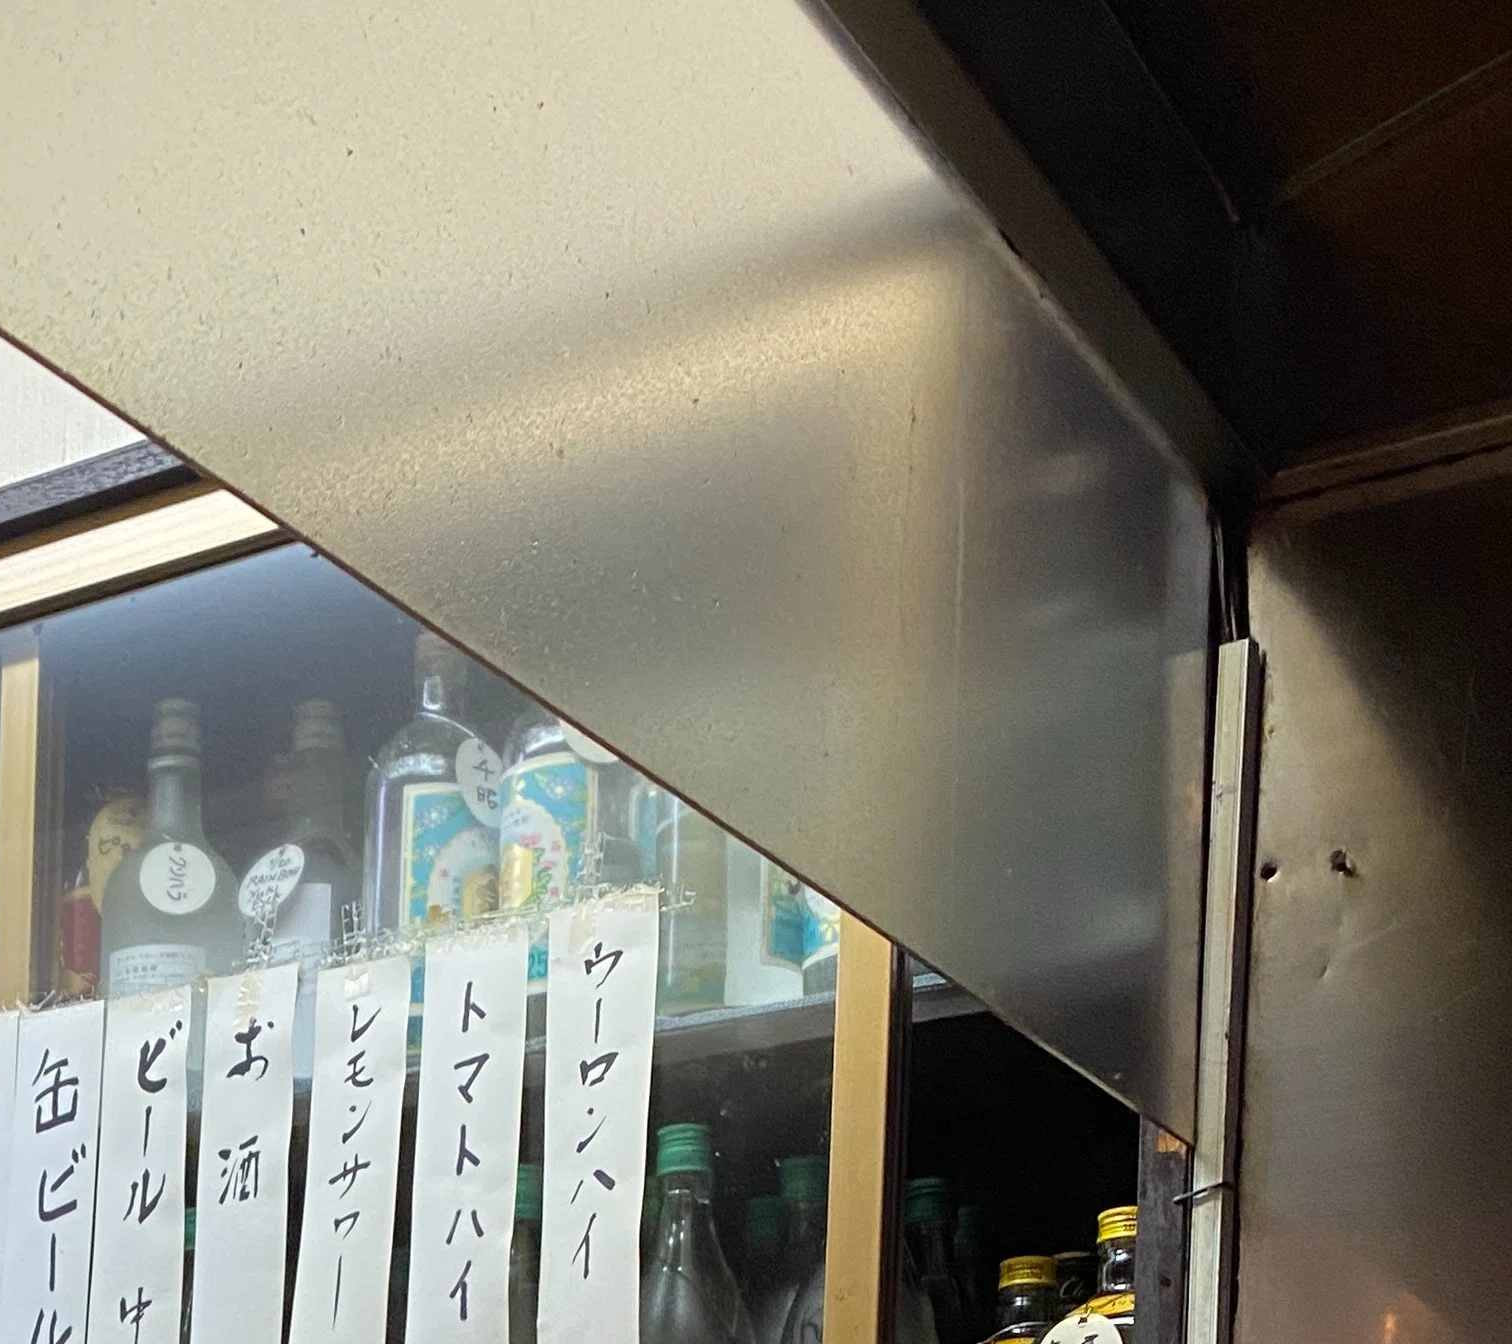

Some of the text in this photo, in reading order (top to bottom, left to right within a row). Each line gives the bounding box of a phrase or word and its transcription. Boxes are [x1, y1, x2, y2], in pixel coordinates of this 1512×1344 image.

[123, 1020, 183, 1224] ビール
[218, 1017, 274, 1205] お酒
[328, 1004, 382, 1331] レモンサワー
[446, 980, 490, 1321] トマトハイ
[571, 941, 624, 1280] ウーロンハイ
